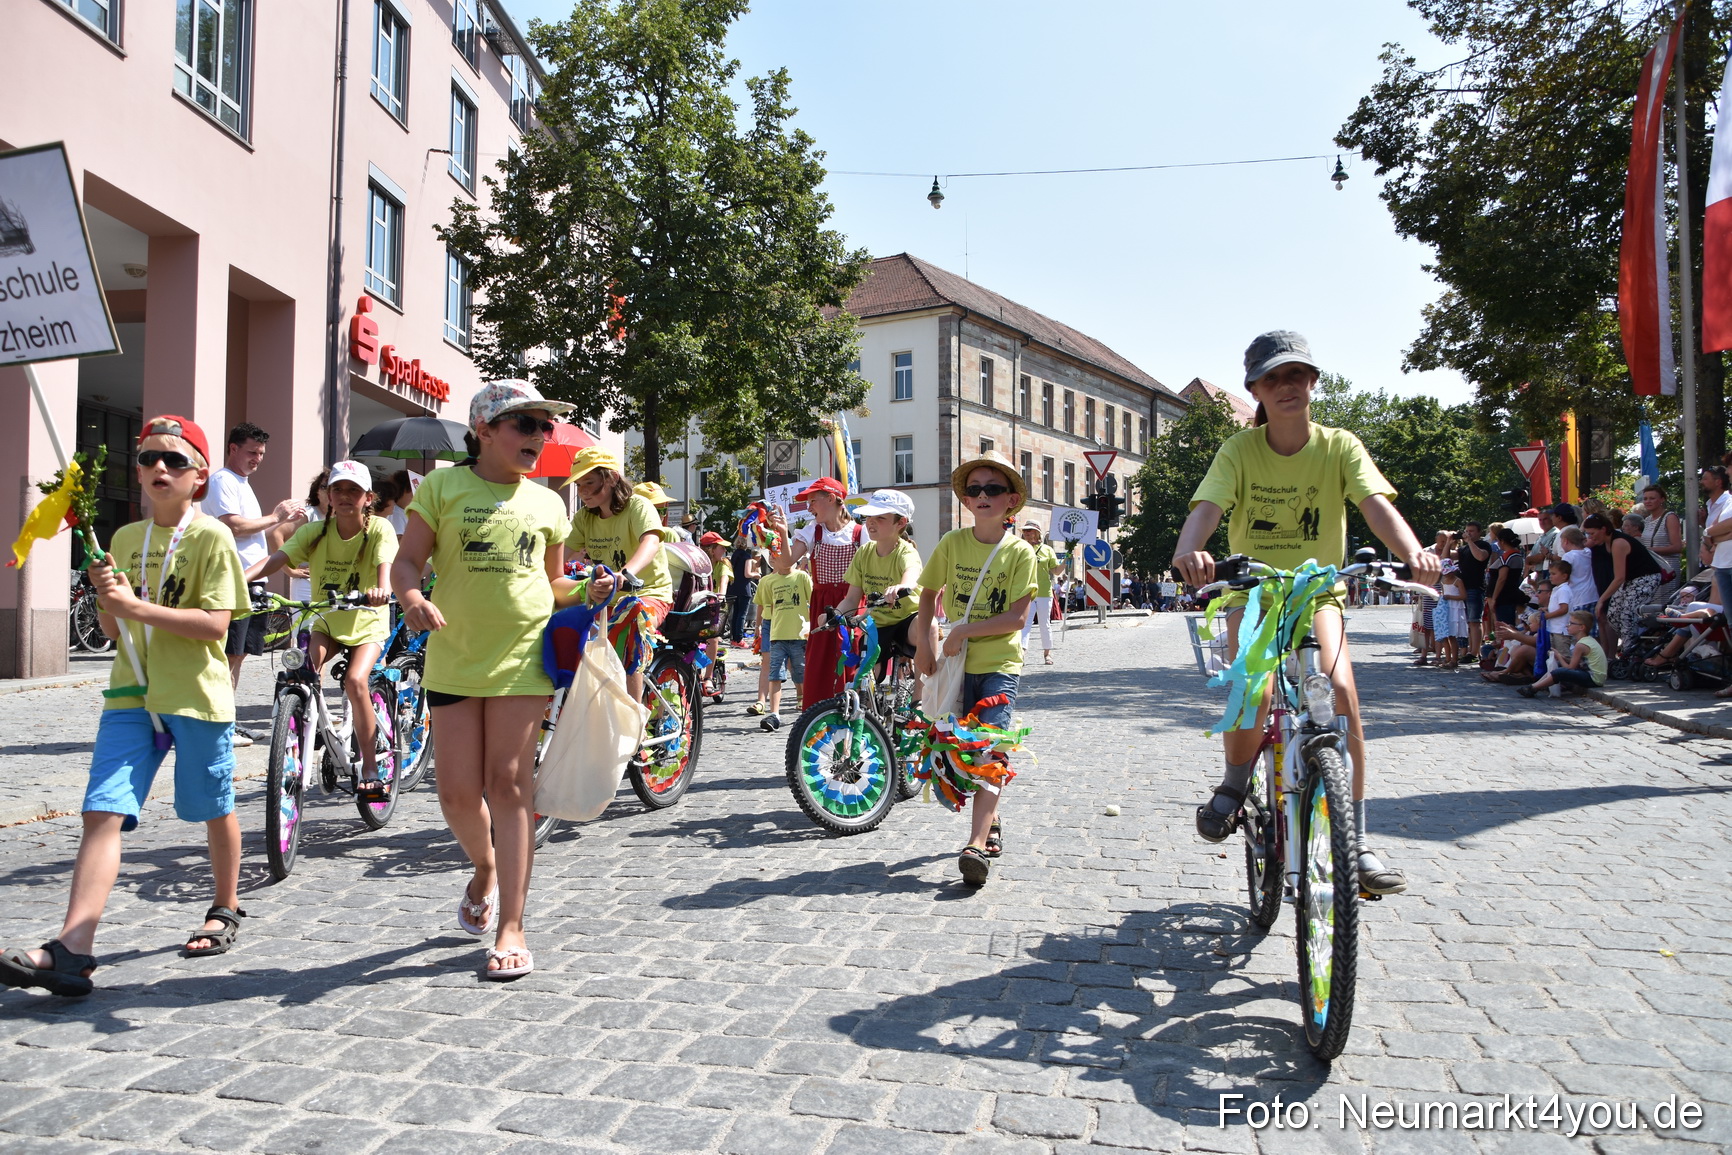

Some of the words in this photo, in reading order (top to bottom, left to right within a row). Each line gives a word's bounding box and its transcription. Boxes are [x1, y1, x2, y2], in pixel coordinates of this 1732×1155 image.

[381, 345, 451, 403] Sparkasse
[1250, 482, 1298, 494] Grundschule
[1250, 494, 1286, 505] Holzheim
[463, 506, 515, 516] Grundschule
[463, 516, 503, 525] Holzheim
[1253, 543, 1302, 551] Umweltschule
[467, 565, 518, 574] Umweltschule
